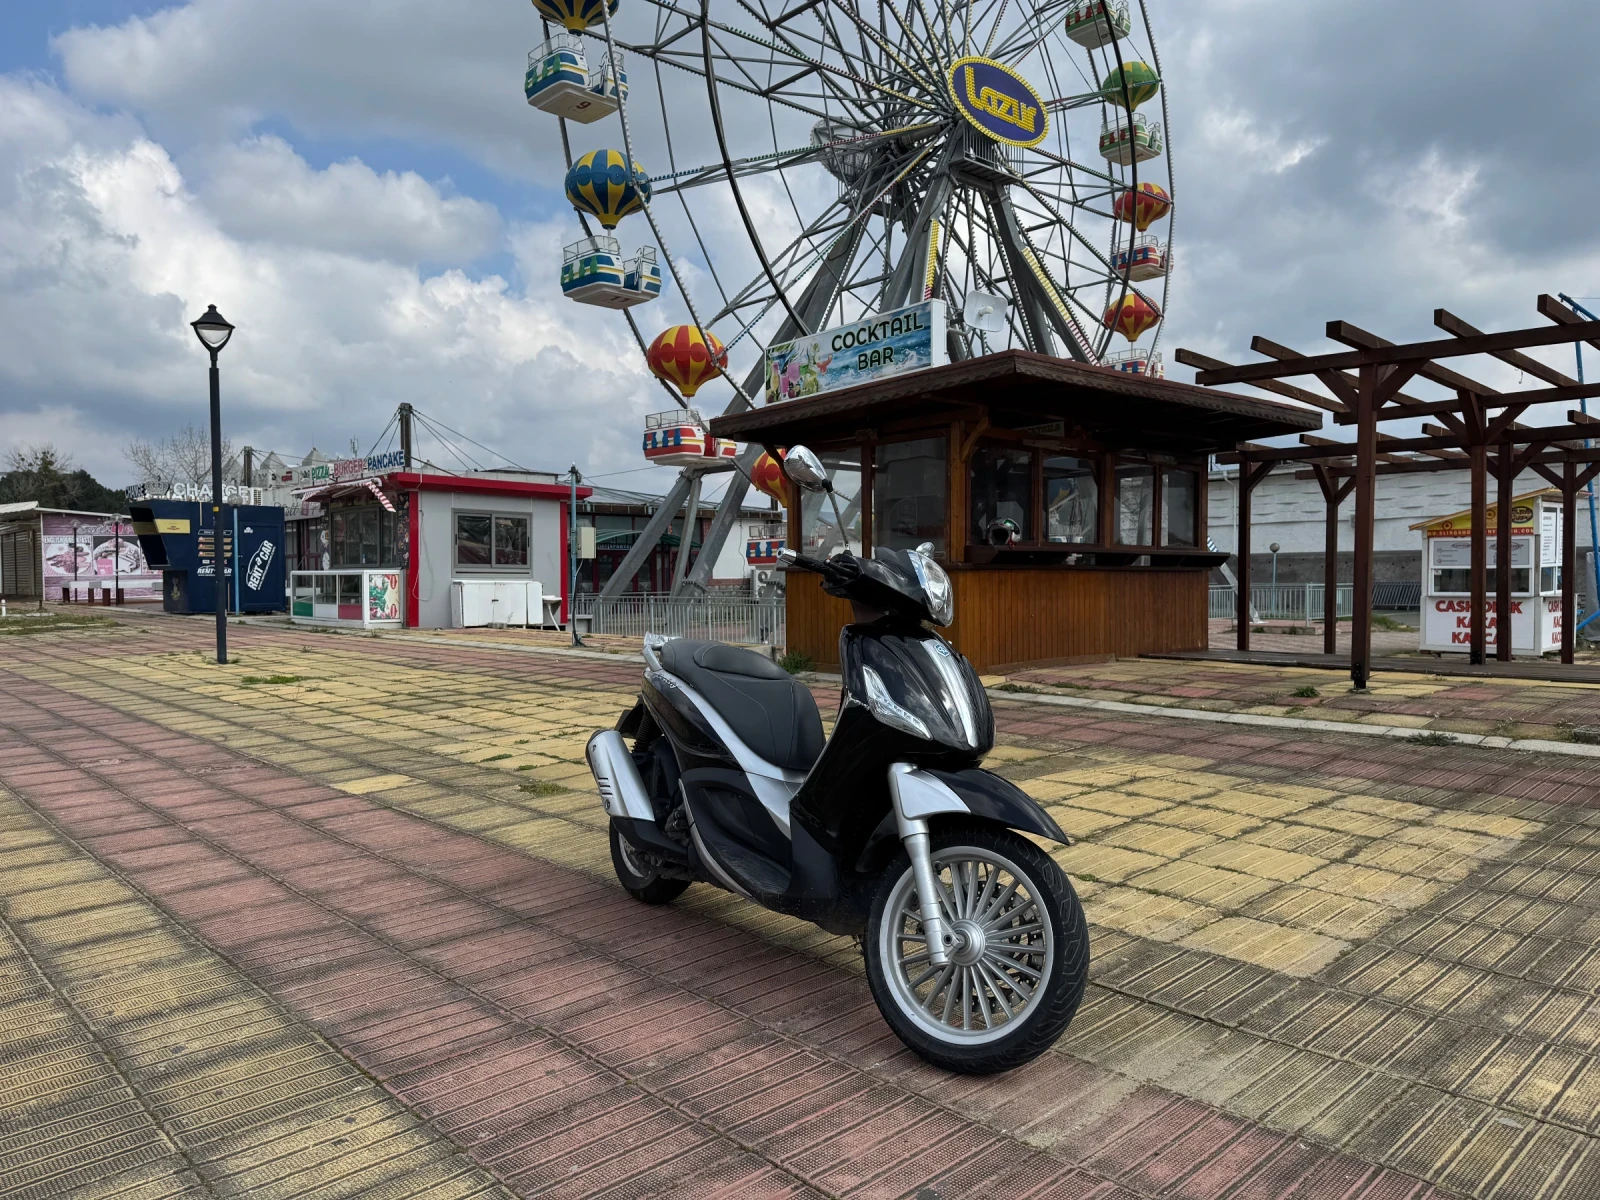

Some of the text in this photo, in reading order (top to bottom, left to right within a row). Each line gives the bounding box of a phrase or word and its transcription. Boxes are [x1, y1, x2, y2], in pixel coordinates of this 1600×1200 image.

[831, 312, 924, 351] COCKTAIL
[858, 347, 894, 371] BAR
[312, 465, 329, 480] PIZZA
[334, 458, 363, 477] BURGER
[368, 450, 404, 471] PANCAKE
[173, 483, 249, 499] CHAGE
[248, 565, 264, 591] RENT
[260, 540, 273, 561] CAR
[1435, 600, 1472, 613] CASH
